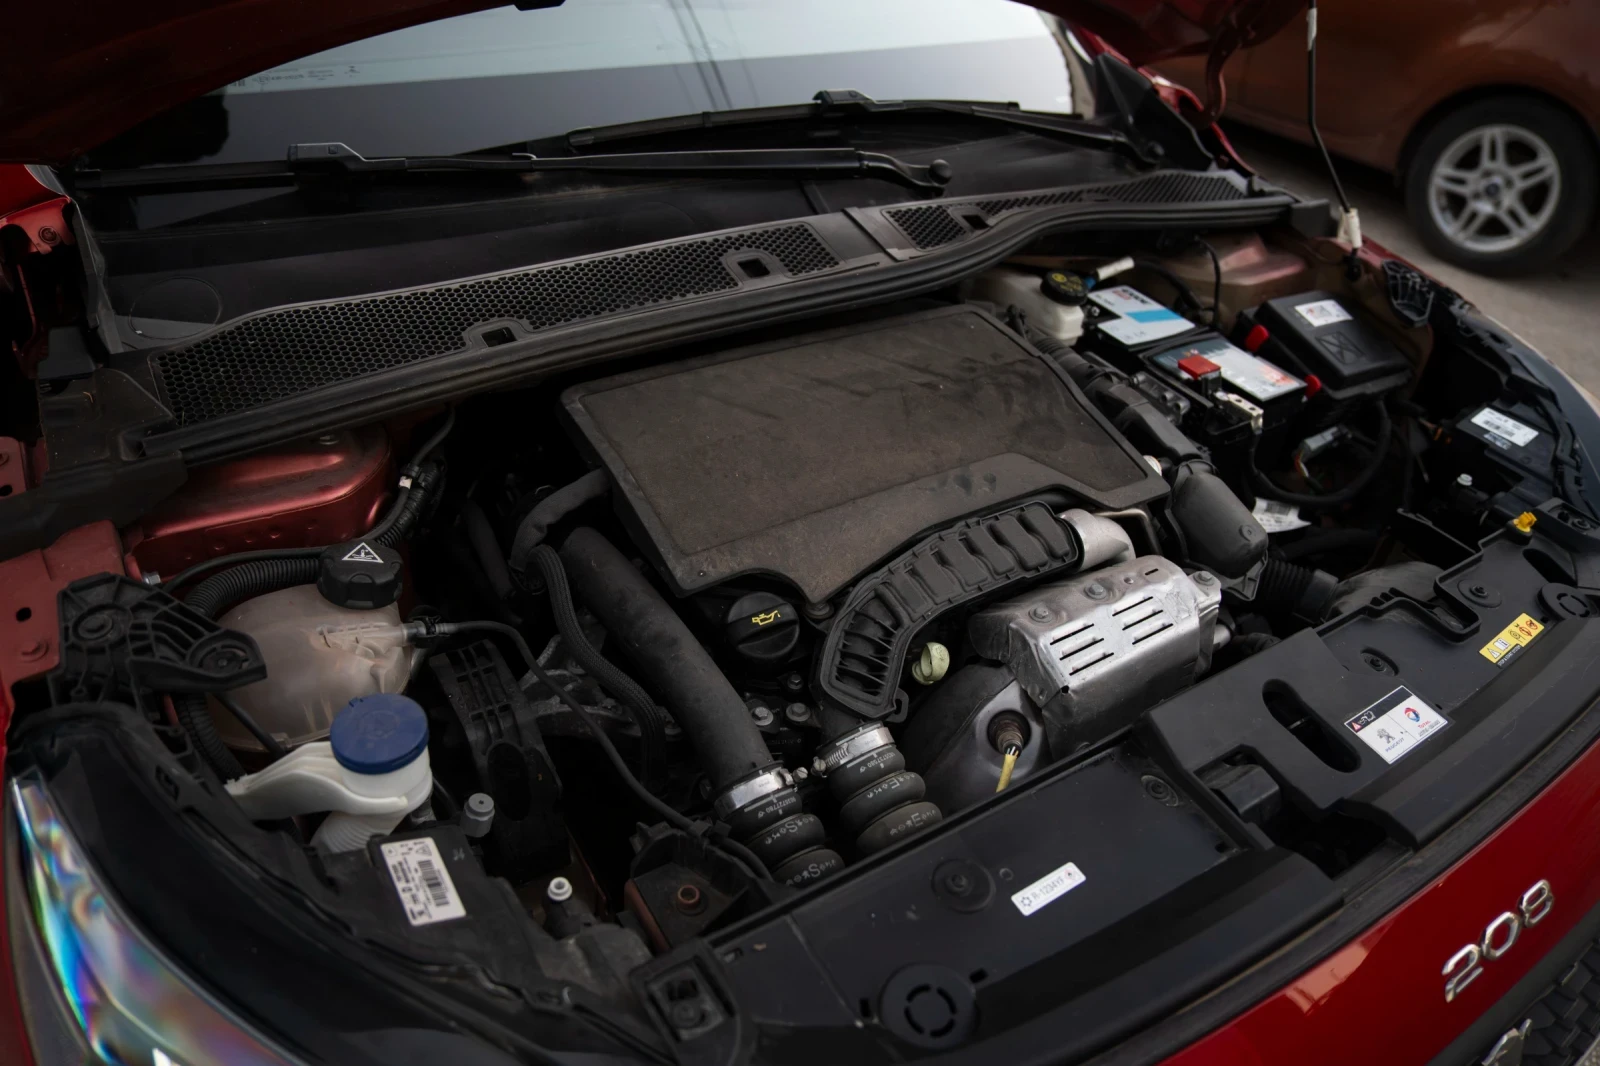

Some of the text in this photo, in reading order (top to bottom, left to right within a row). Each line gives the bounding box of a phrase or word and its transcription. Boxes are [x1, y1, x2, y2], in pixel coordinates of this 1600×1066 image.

[910, 812, 924, 827] E
[784, 821, 798, 833] S
[808, 863, 821, 877] S
[1441, 879, 1555, 1004] 208
